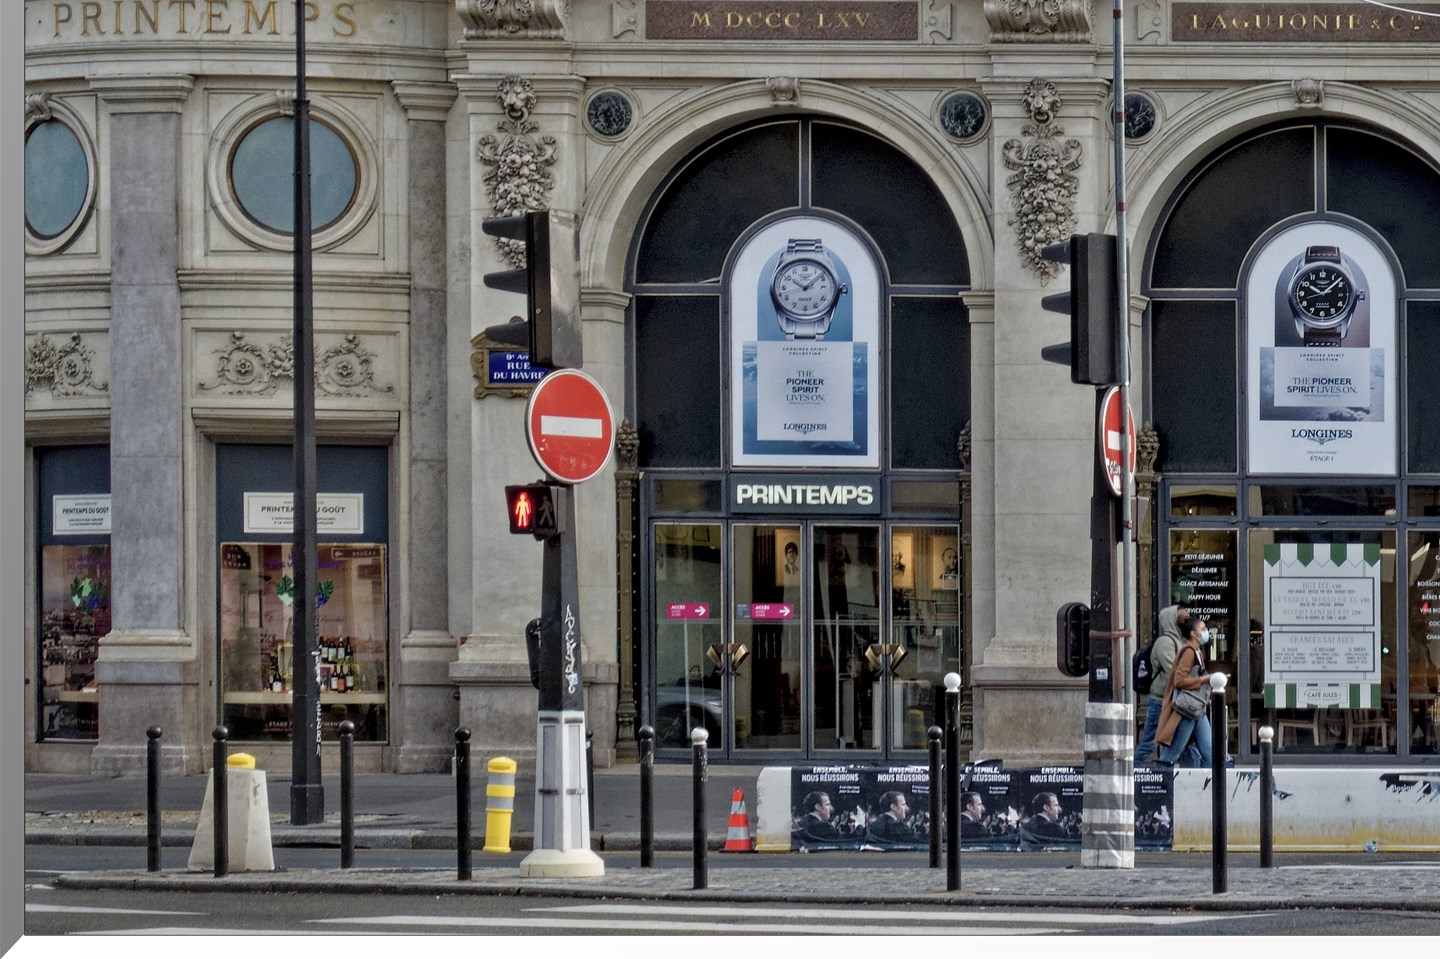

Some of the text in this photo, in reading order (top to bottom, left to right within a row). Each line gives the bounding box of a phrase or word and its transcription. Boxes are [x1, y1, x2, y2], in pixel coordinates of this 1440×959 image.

[52, 0, 358, 38] PRINTEMPS
[690, 11, 872, 29] M DCCC LXV
[1371, 17, 1381, 30] &
[507, 361, 531, 370] RUE
[493, 371, 508, 380] DU
[797, 370, 815, 378] THE
[1292, 377, 1352, 385] THE PIONEER
[1316, 386, 1341, 394] LIVES
[1342, 386, 1358, 394] ON.
[1291, 429, 1353, 438] LONGINES
[736, 484, 874, 505] PRINTEMPS
[321, 505, 346, 513] GOÛT
[965, 766, 1000, 774] ESEMBLE,
[801, 772, 859, 782] NOUS RÉUSSIRONS
[877, 772, 929, 782] NOUS RÉUSSIRON
[1030, 773, 1083, 783] NOUS RÉUSSIRON
